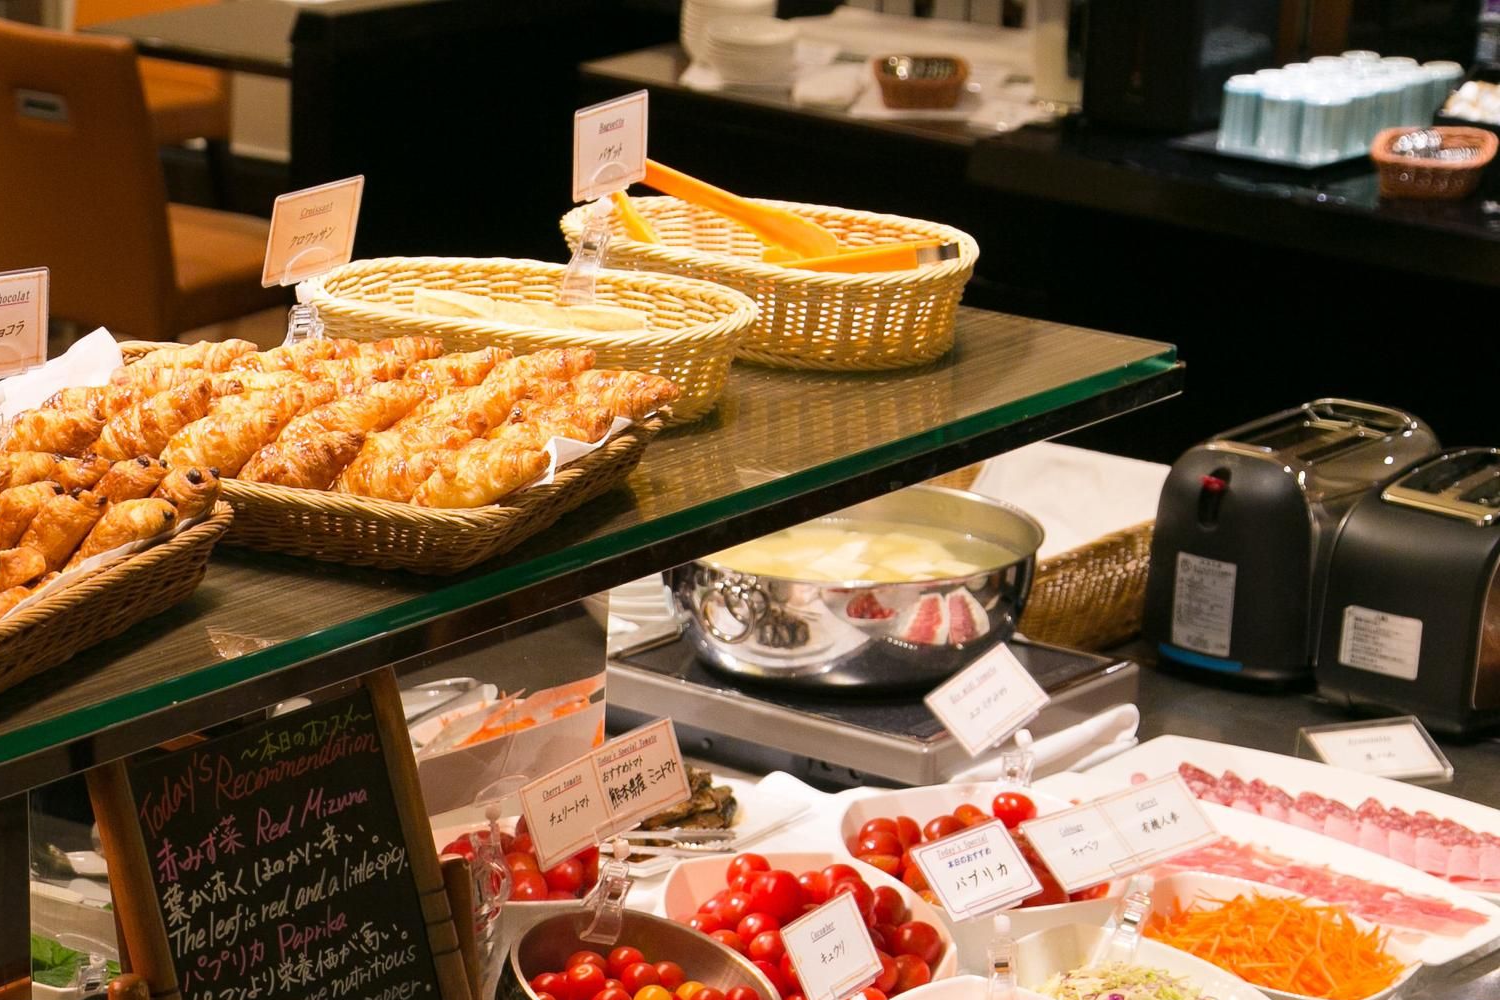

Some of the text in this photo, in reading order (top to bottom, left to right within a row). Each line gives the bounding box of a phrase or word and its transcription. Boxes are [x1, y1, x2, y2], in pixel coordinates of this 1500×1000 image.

[156, 787, 369, 884] 赤みず菜 Red Mizuna
[548, 796, 591, 828] チェリートマト
[168, 921, 207, 959] The
[209, 903, 243, 948] leaf
[244, 907, 258, 933] is
[294, 867, 327, 911] and
[328, 875, 340, 898] a
[343, 850, 377, 892] little
[184, 905, 349, 994] パプリカ Paprika
[332, 943, 417, 998] nutritious
